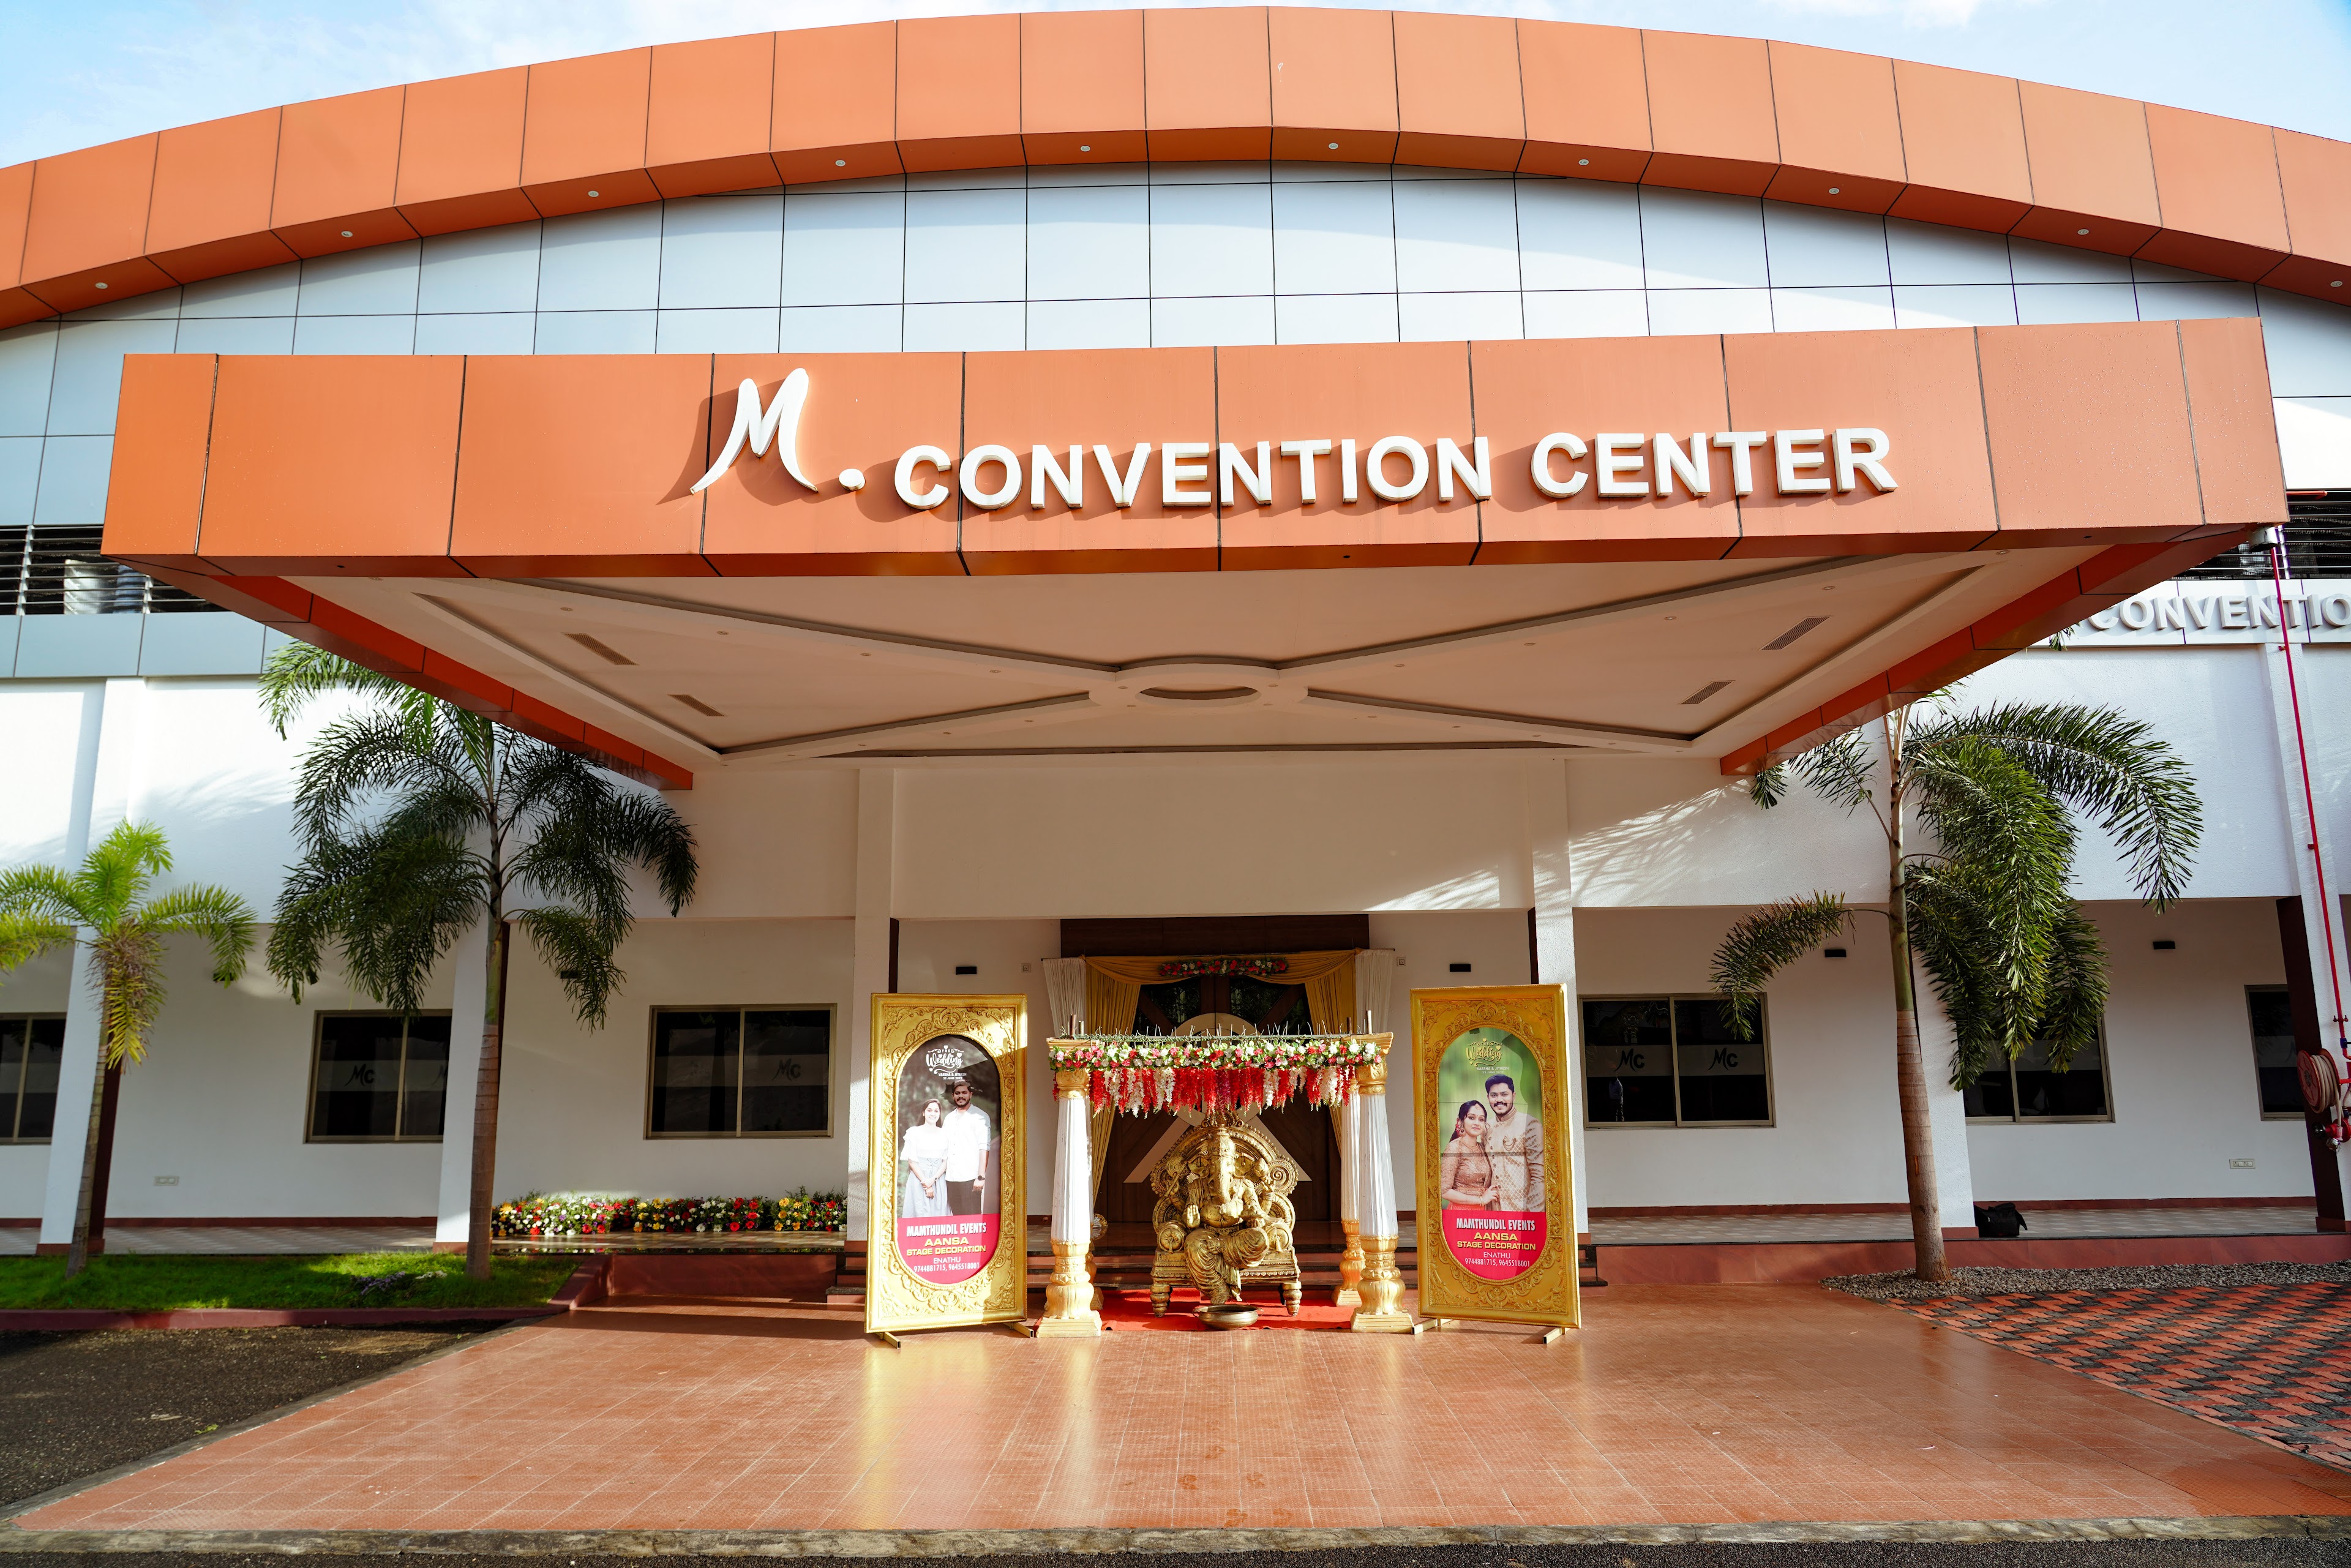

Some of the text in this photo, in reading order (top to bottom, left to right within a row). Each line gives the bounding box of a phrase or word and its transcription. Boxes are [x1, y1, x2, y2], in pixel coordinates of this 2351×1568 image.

[894, 435, 1491, 510] CONVENTION
[1531, 427, 1897, 498] CENTER
[926, 1053, 963, 1068] Wedding
[1466, 1046, 1502, 1062] Wedding
[907, 1222, 987, 1237] MAMTHUNDIL EVENTS
[1456, 1218, 1535, 1231] MAMTHUNDIL EVENTS
[924, 1237, 969, 1247] AANSA
[1474, 1232, 1518, 1241] AANSA
[935, 1245, 986, 1255] DECORATION
[1485, 1242, 1536, 1250] DECORATION
